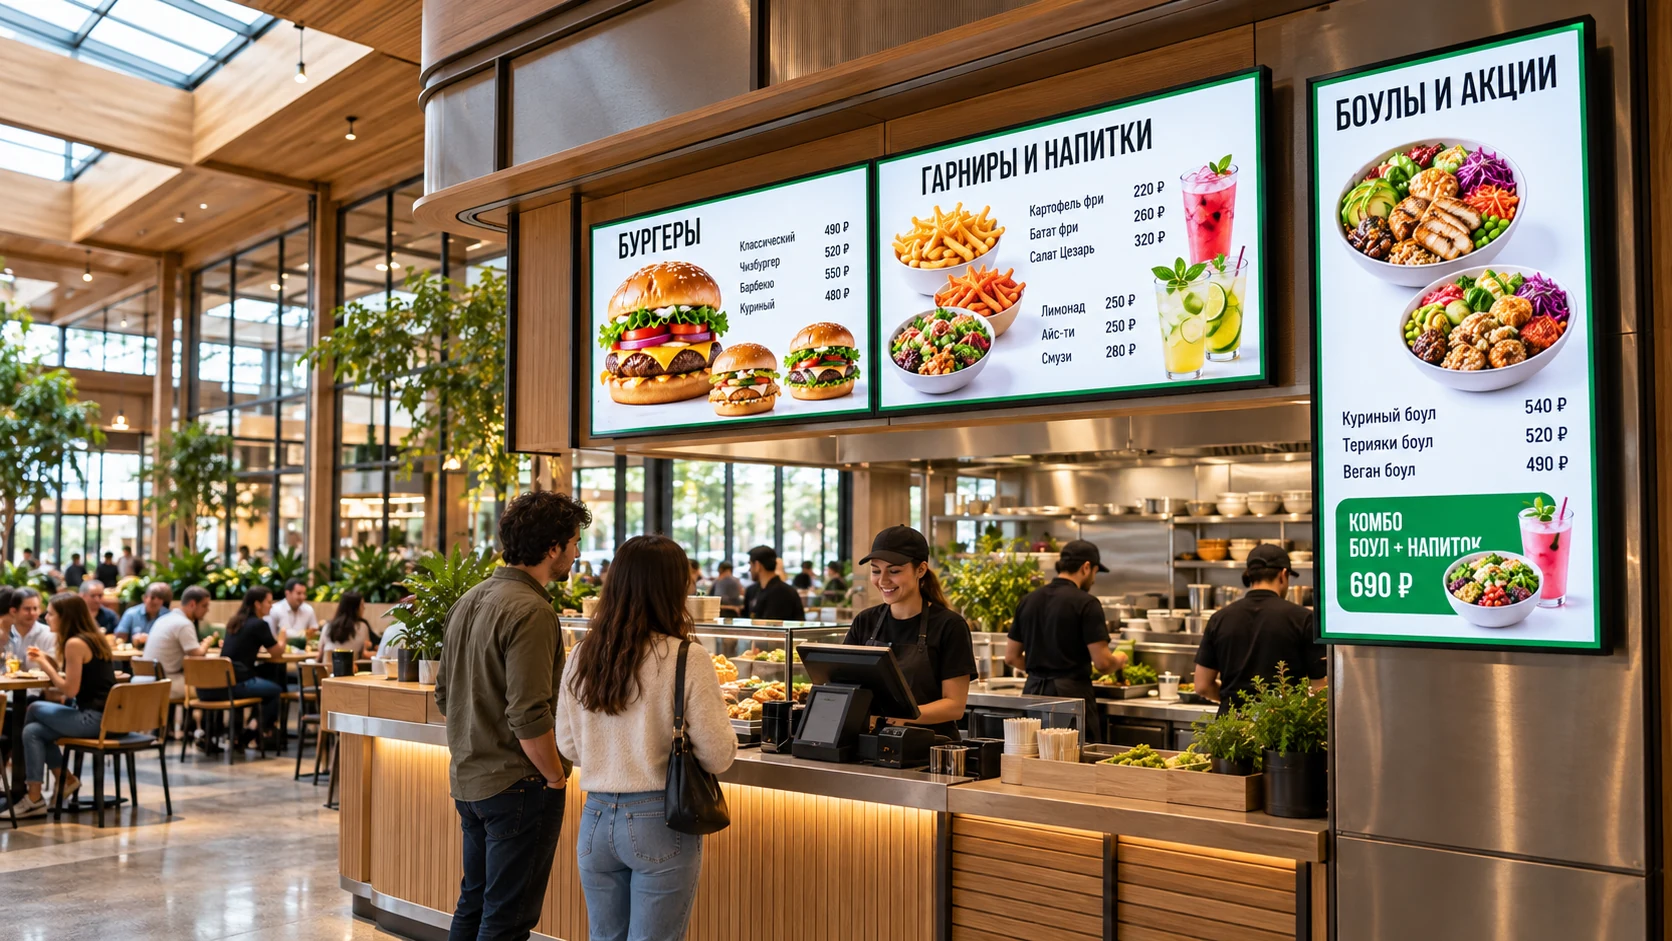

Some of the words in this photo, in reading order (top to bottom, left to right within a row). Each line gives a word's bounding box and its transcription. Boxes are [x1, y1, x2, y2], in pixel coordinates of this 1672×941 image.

[1336, 81, 1426, 131] БОУЛЫ
[1435, 76, 1452, 111] И
[1461, 54, 1557, 106] АКЦИИ
[921, 147, 1018, 195] ГАРНИРЫ
[1024, 143, 1038, 174] И
[1045, 118, 1153, 170] НАПИТКИ
[1029, 199, 1082, 218] Картофель
[1083, 194, 1104, 210] фри
[1133, 182, 1154, 198] 220
[1156, 180, 1165, 194] ₽
[618, 217, 701, 259] БУРГЕРЫ
[739, 230, 796, 252] Классический
[824, 222, 841, 236] 490
[842, 220, 850, 233] ₽
[1029, 226, 1057, 241] Батат
[1058, 222, 1079, 238] фри
[1133, 207, 1155, 223] 260
[1156, 205, 1166, 219] ₽
[739, 257, 781, 273] Чизбургер
[824, 244, 841, 258] 520
[842, 242, 850, 255] ₽
[1029, 249, 1058, 264] Салат
[1059, 244, 1095, 261] Цезарь
[1134, 231, 1155, 248] 320
[1157, 230, 1166, 244] ₽
[739, 279, 775, 295] Барбекю
[824, 266, 841, 280] 550
[843, 264, 850, 277] ₽
[739, 298, 775, 316] Куриный
[824, 288, 842, 302] 480
[843, 287, 850, 299] ₽
[1041, 302, 1086, 318] Лимонад
[1105, 294, 1125, 310] 250
[1127, 293, 1136, 307] ₽
[1041, 327, 1075, 341] Айс-ти
[1105, 319, 1125, 334] 250
[1127, 317, 1137, 331] ₽
[1041, 351, 1072, 367] Смузи
[1105, 343, 1126, 359] 280
[1128, 342, 1137, 356] ₽
[1342, 407, 1401, 429] Куриный
[1404, 406, 1436, 425] боул
[1524, 397, 1553, 415] 540
[1556, 396, 1568, 413] ₽
[1342, 437, 1398, 456] Терияки
[1401, 433, 1434, 453] боул
[1525, 426, 1553, 444] 520
[1557, 426, 1568, 442] ₽
[1343, 464, 1381, 480] Веган
[1384, 462, 1416, 481] боул
[1525, 455, 1554, 472] 490
[1558, 455, 1569, 471] ₽
[1349, 511, 1403, 532] КОМБО
[1349, 537, 1389, 558] БОУЛ
[1393, 542, 1404, 553] +
[1350, 571, 1391, 598] 690
[1397, 572, 1413, 598] ₽
